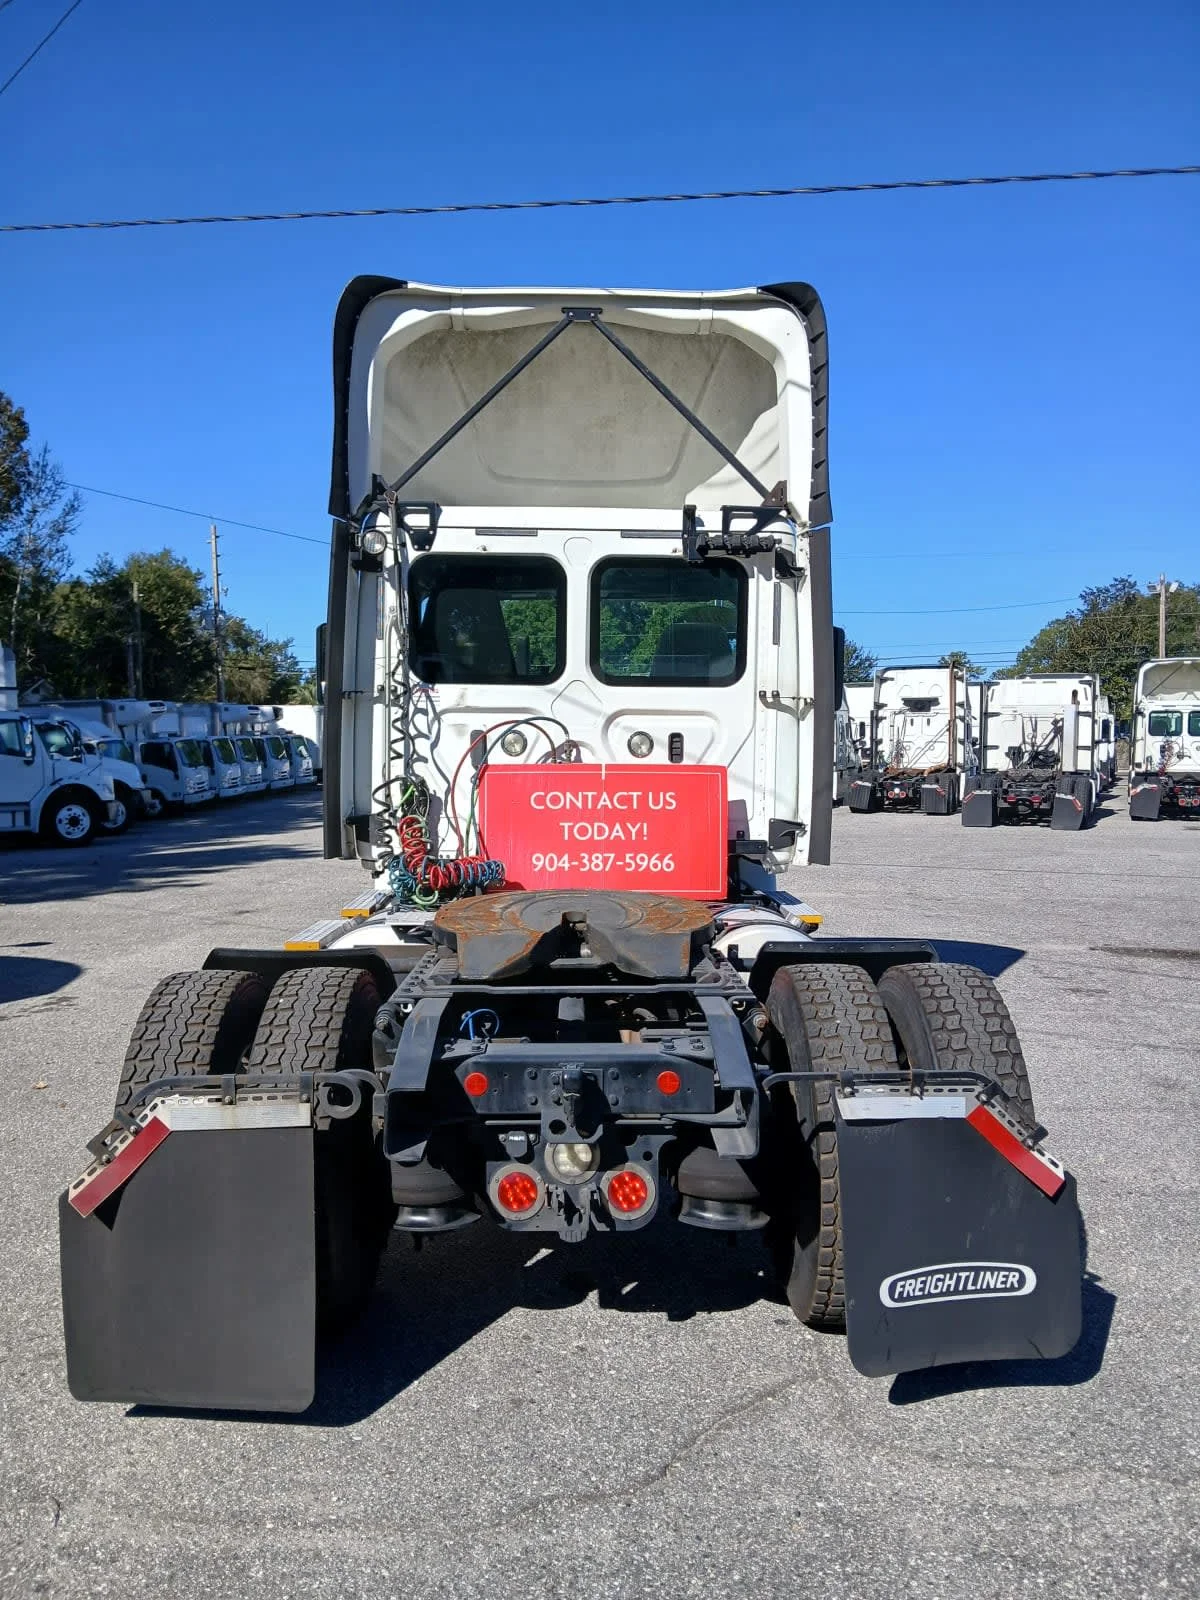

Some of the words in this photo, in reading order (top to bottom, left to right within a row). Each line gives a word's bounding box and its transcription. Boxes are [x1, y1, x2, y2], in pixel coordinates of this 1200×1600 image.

[530, 791, 642, 811] CONTACT
[649, 791, 677, 811] US
[560, 822, 648, 841] TODAY!
[531, 853, 675, 873] 904-387-5966
[894, 1271, 1020, 1299] FREIGHTLINER
